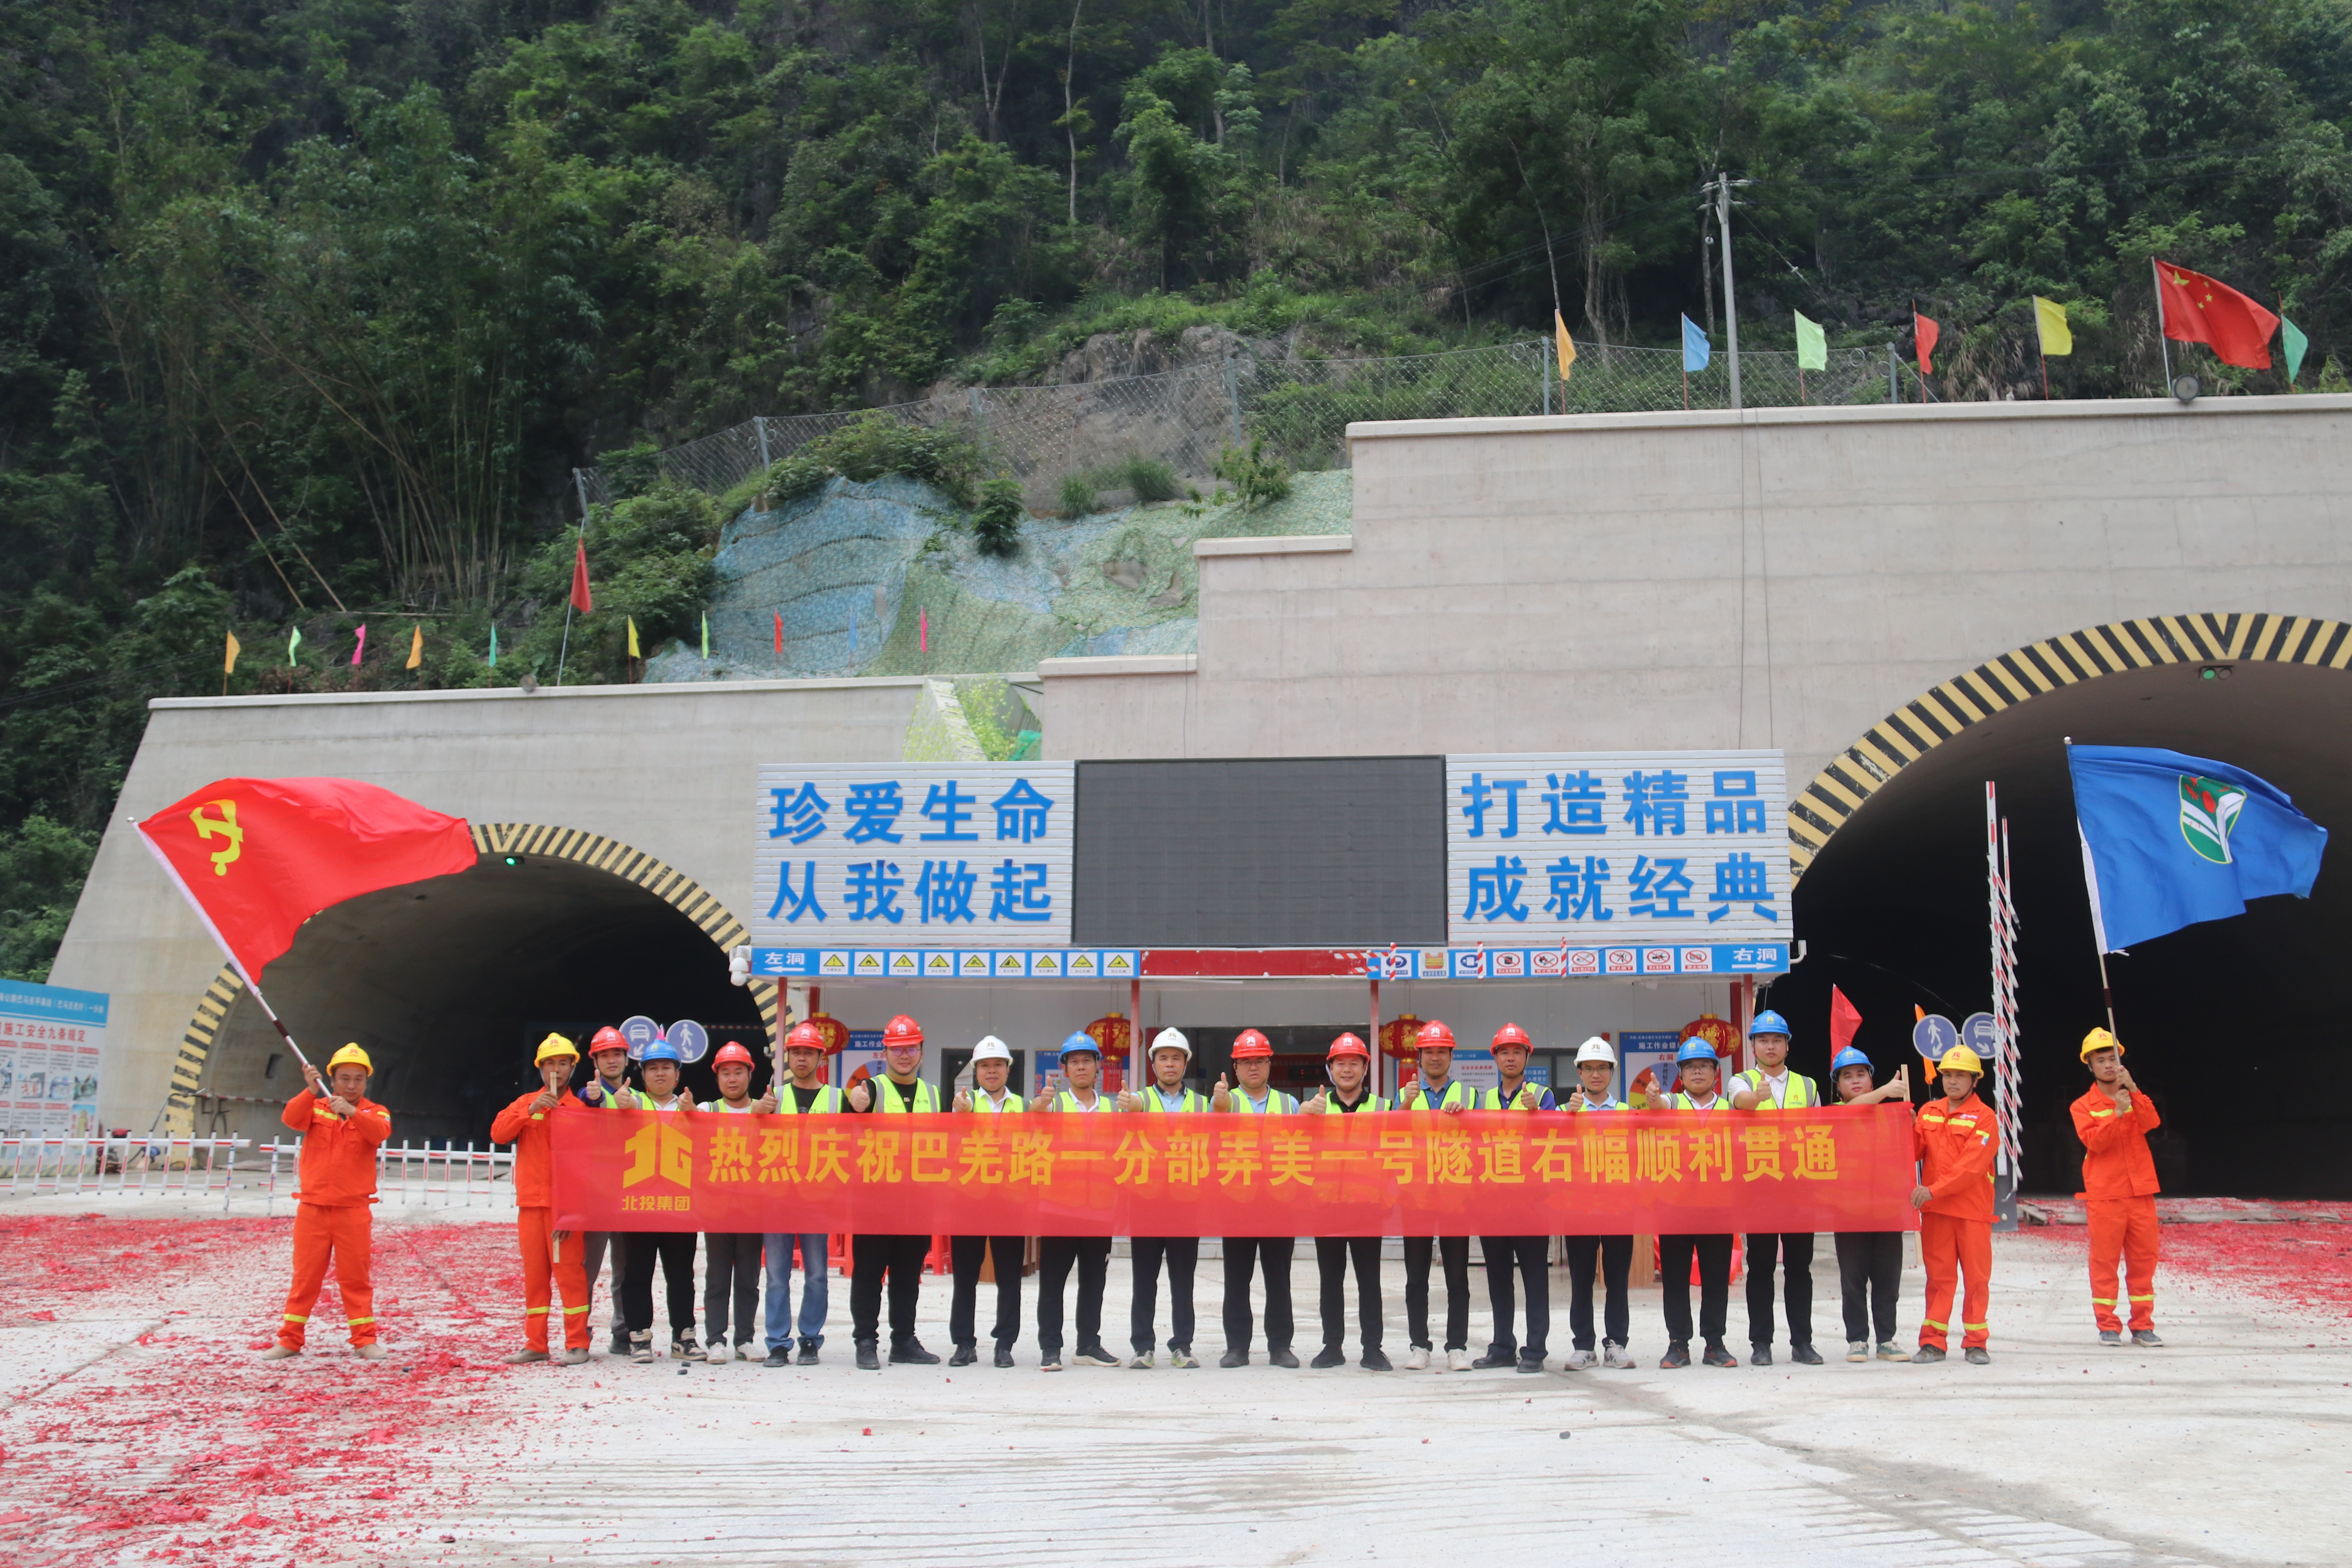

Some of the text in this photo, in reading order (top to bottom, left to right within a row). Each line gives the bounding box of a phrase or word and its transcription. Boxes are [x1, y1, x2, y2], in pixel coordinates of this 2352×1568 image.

[768, 778, 1054, 845] 珍爱生命
[1461, 769, 1766, 838] 打造精品
[766, 859, 1053, 924] 从我做起
[1463, 852, 1778, 923] 成就经典
[765, 952, 805, 965] 左洞
[1733, 947, 1777, 962] 右洞
[0, 1021, 85, 1042] 施工安全九条规定
[708, 1125, 1839, 1186] 热烈庆祝巴羌路一分部弄美一号隧道右幅顺利贯通
[622, 1196, 690, 1211] 北投集团
